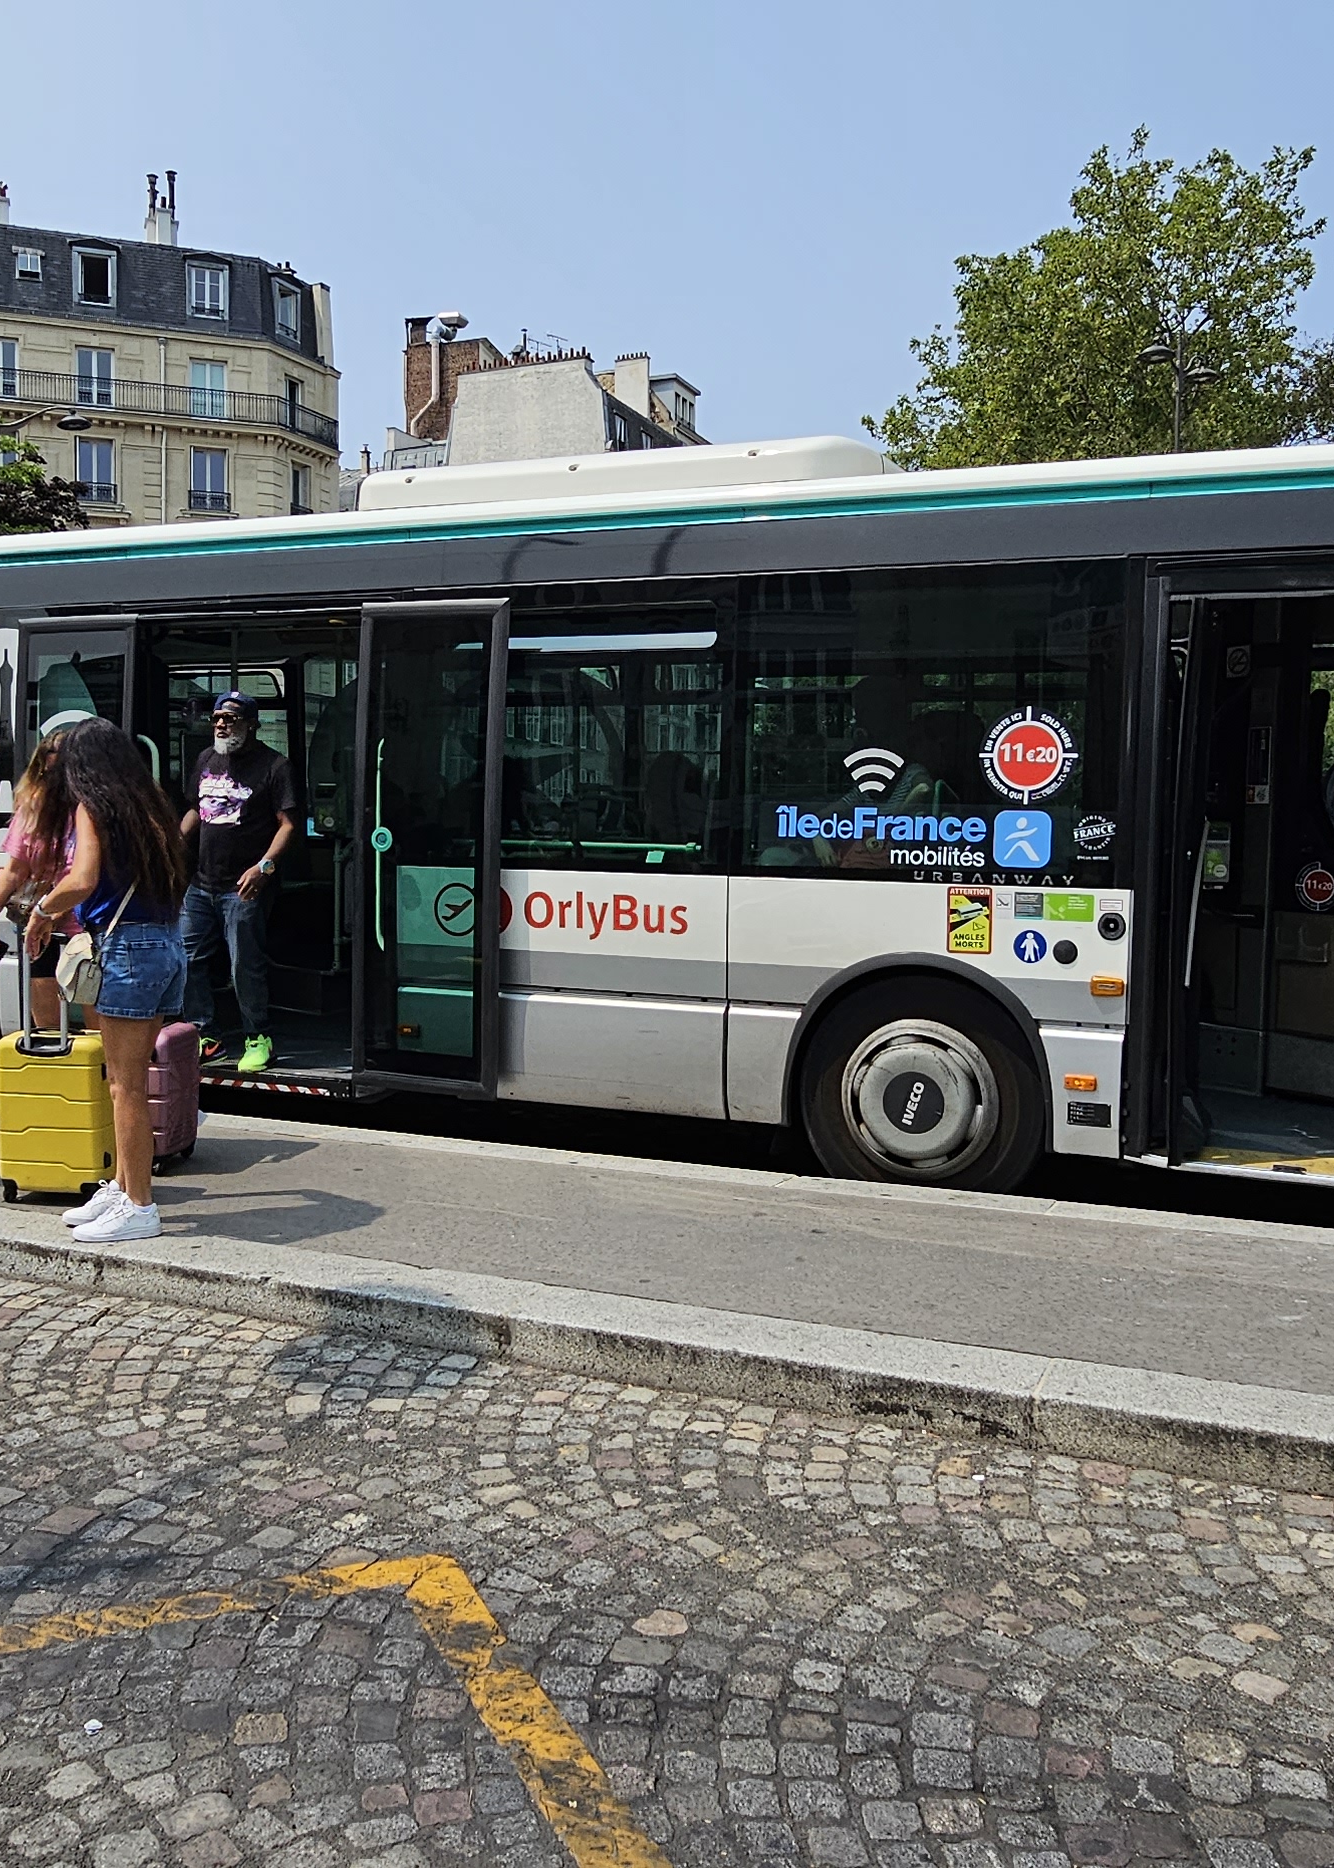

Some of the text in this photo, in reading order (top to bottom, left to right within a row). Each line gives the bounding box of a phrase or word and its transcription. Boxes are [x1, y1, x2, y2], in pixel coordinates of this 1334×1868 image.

[989, 718, 1012, 739] VENTE
[1040, 713, 1073, 749] SOLD HERE
[1000, 742, 1058, 764] 11€20
[986, 767, 1009, 796] VENDITA
[1008, 790, 1023, 800] QUI
[776, 805, 987, 843] îledeFrance
[1073, 824, 1115, 840] FRANCE
[890, 846, 985, 868] mobilités
[913, 870, 1075, 886] URBANWAY
[949, 887, 991, 896] ATTENTION
[523, 890, 689, 941] OrlyBus
[953, 933, 985, 942] ANGLES
[954, 940, 984, 949] MORTS
[901, 1081, 925, 1126] IVECO
